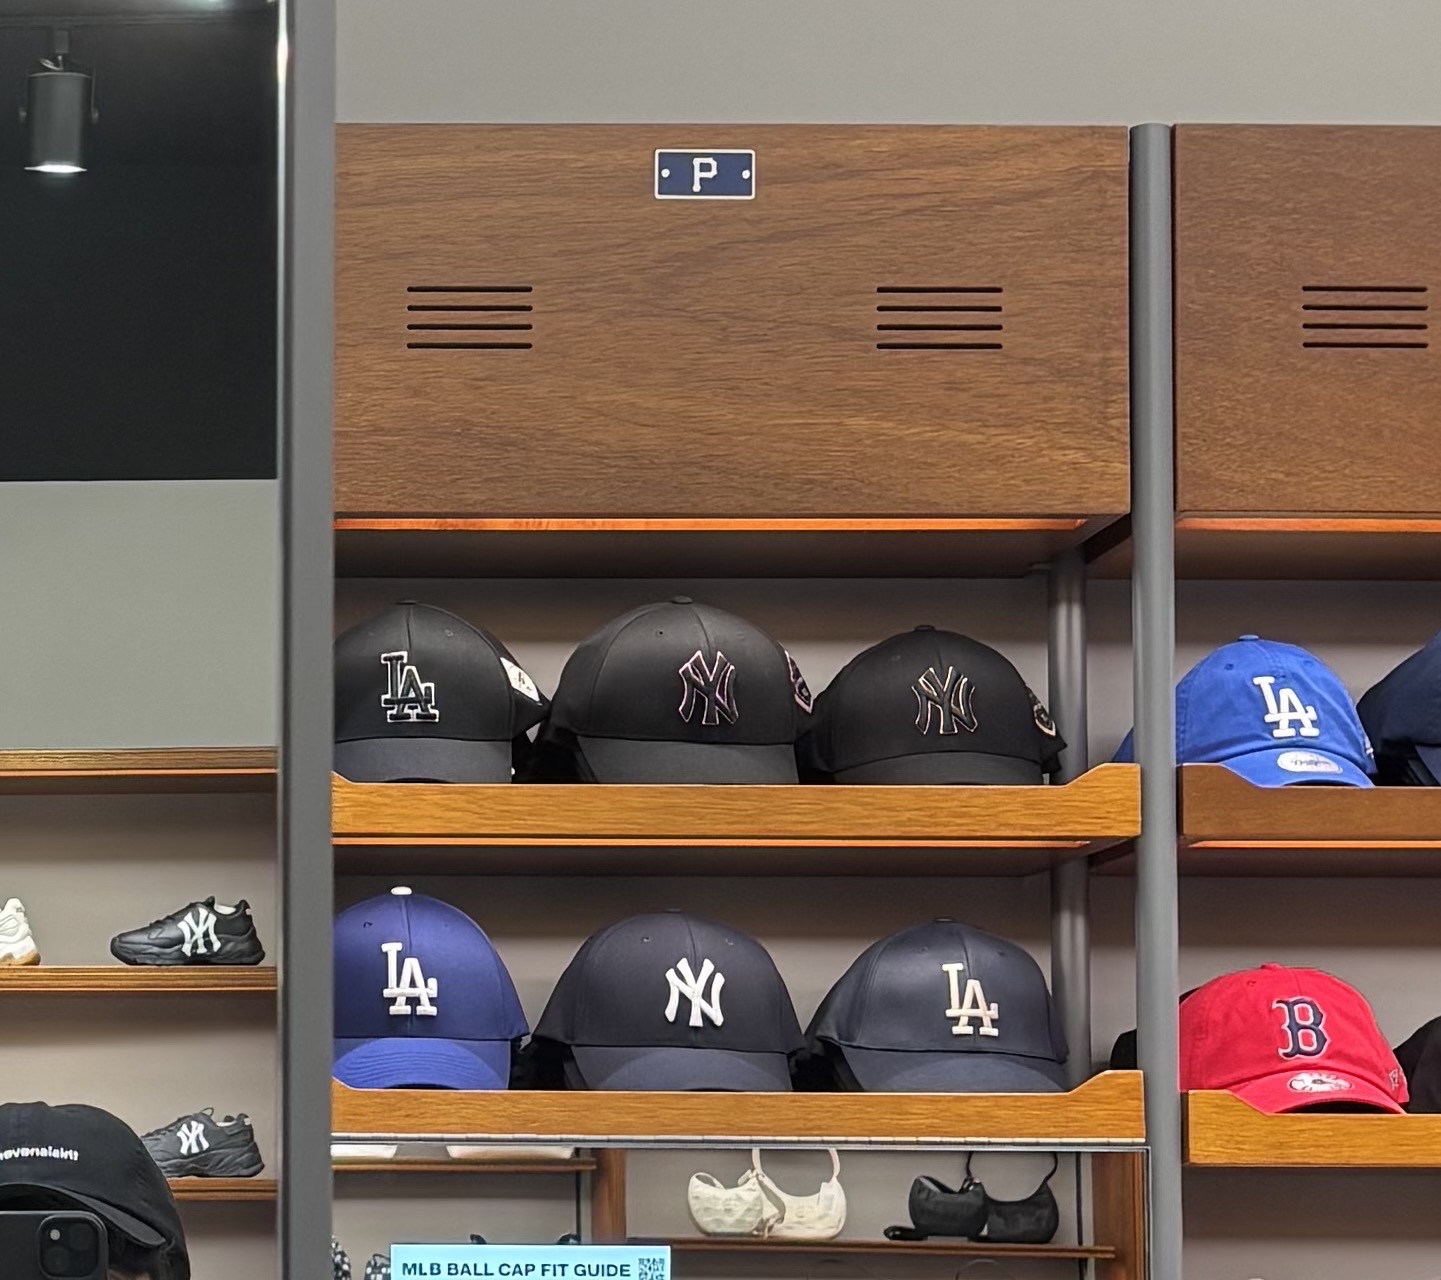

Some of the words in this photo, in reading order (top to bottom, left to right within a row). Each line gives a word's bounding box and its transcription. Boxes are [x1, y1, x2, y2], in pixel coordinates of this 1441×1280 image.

[692, 157, 718, 192] P
[381, 651, 440, 724] LA
[678, 649, 740, 726] NY
[910, 665, 979, 735] NY
[1252, 674, 1320, 738] LA
[380, 942, 438, 1017] LA
[664, 957, 726, 1027] NY
[941, 962, 1000, 1036] LA
[1271, 997, 1328, 1060] B
[402, 1262, 442, 1277] MLB
[447, 1262, 494, 1277] BALL
[498, 1263, 536, 1277] CAP
[541, 1263, 570, 1277] FIT
[574, 1263, 631, 1277] GUIDE
